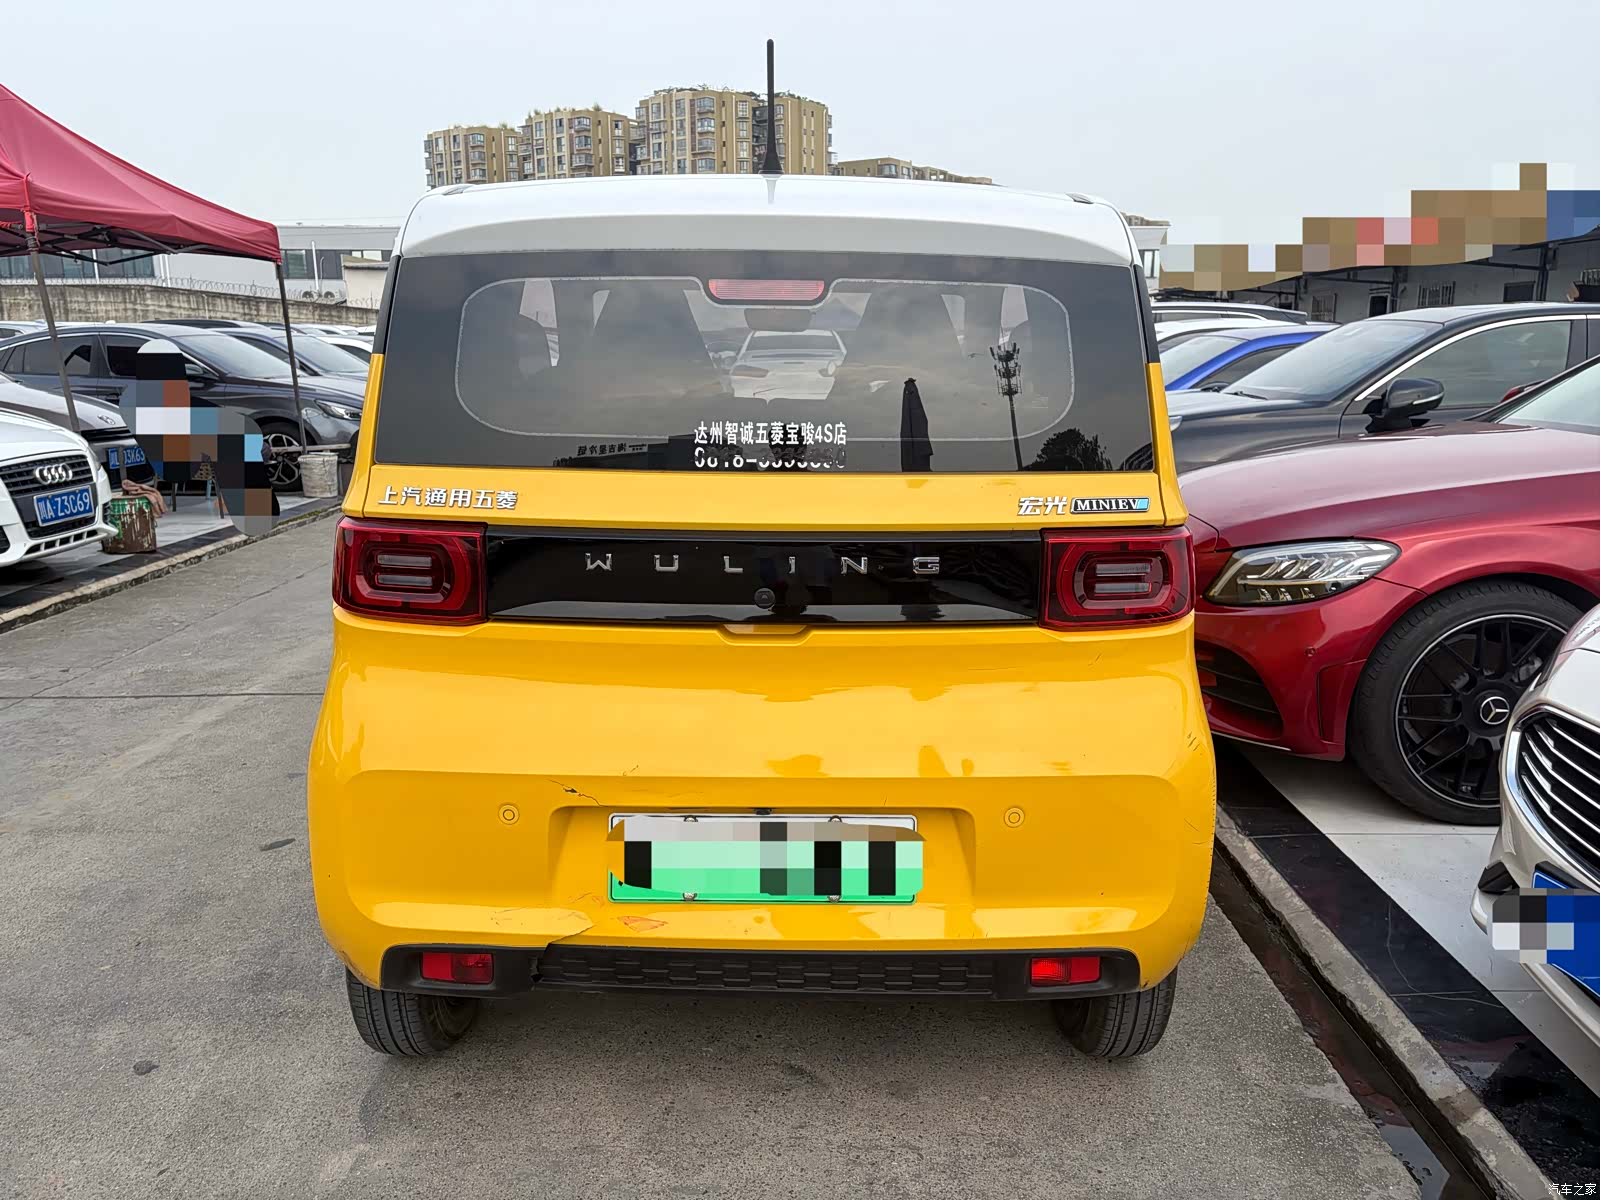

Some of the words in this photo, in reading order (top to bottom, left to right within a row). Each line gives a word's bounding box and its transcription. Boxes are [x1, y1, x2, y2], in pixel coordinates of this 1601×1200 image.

[694, 421, 847, 445] 达州智诚五菱宝骏4S店
[378, 486, 518, 509] 上汽通用五菱
[1017, 496, 1067, 515] 宏光
[1076, 498, 1139, 511] MINIEV
[585, 553, 940, 574] WULING
